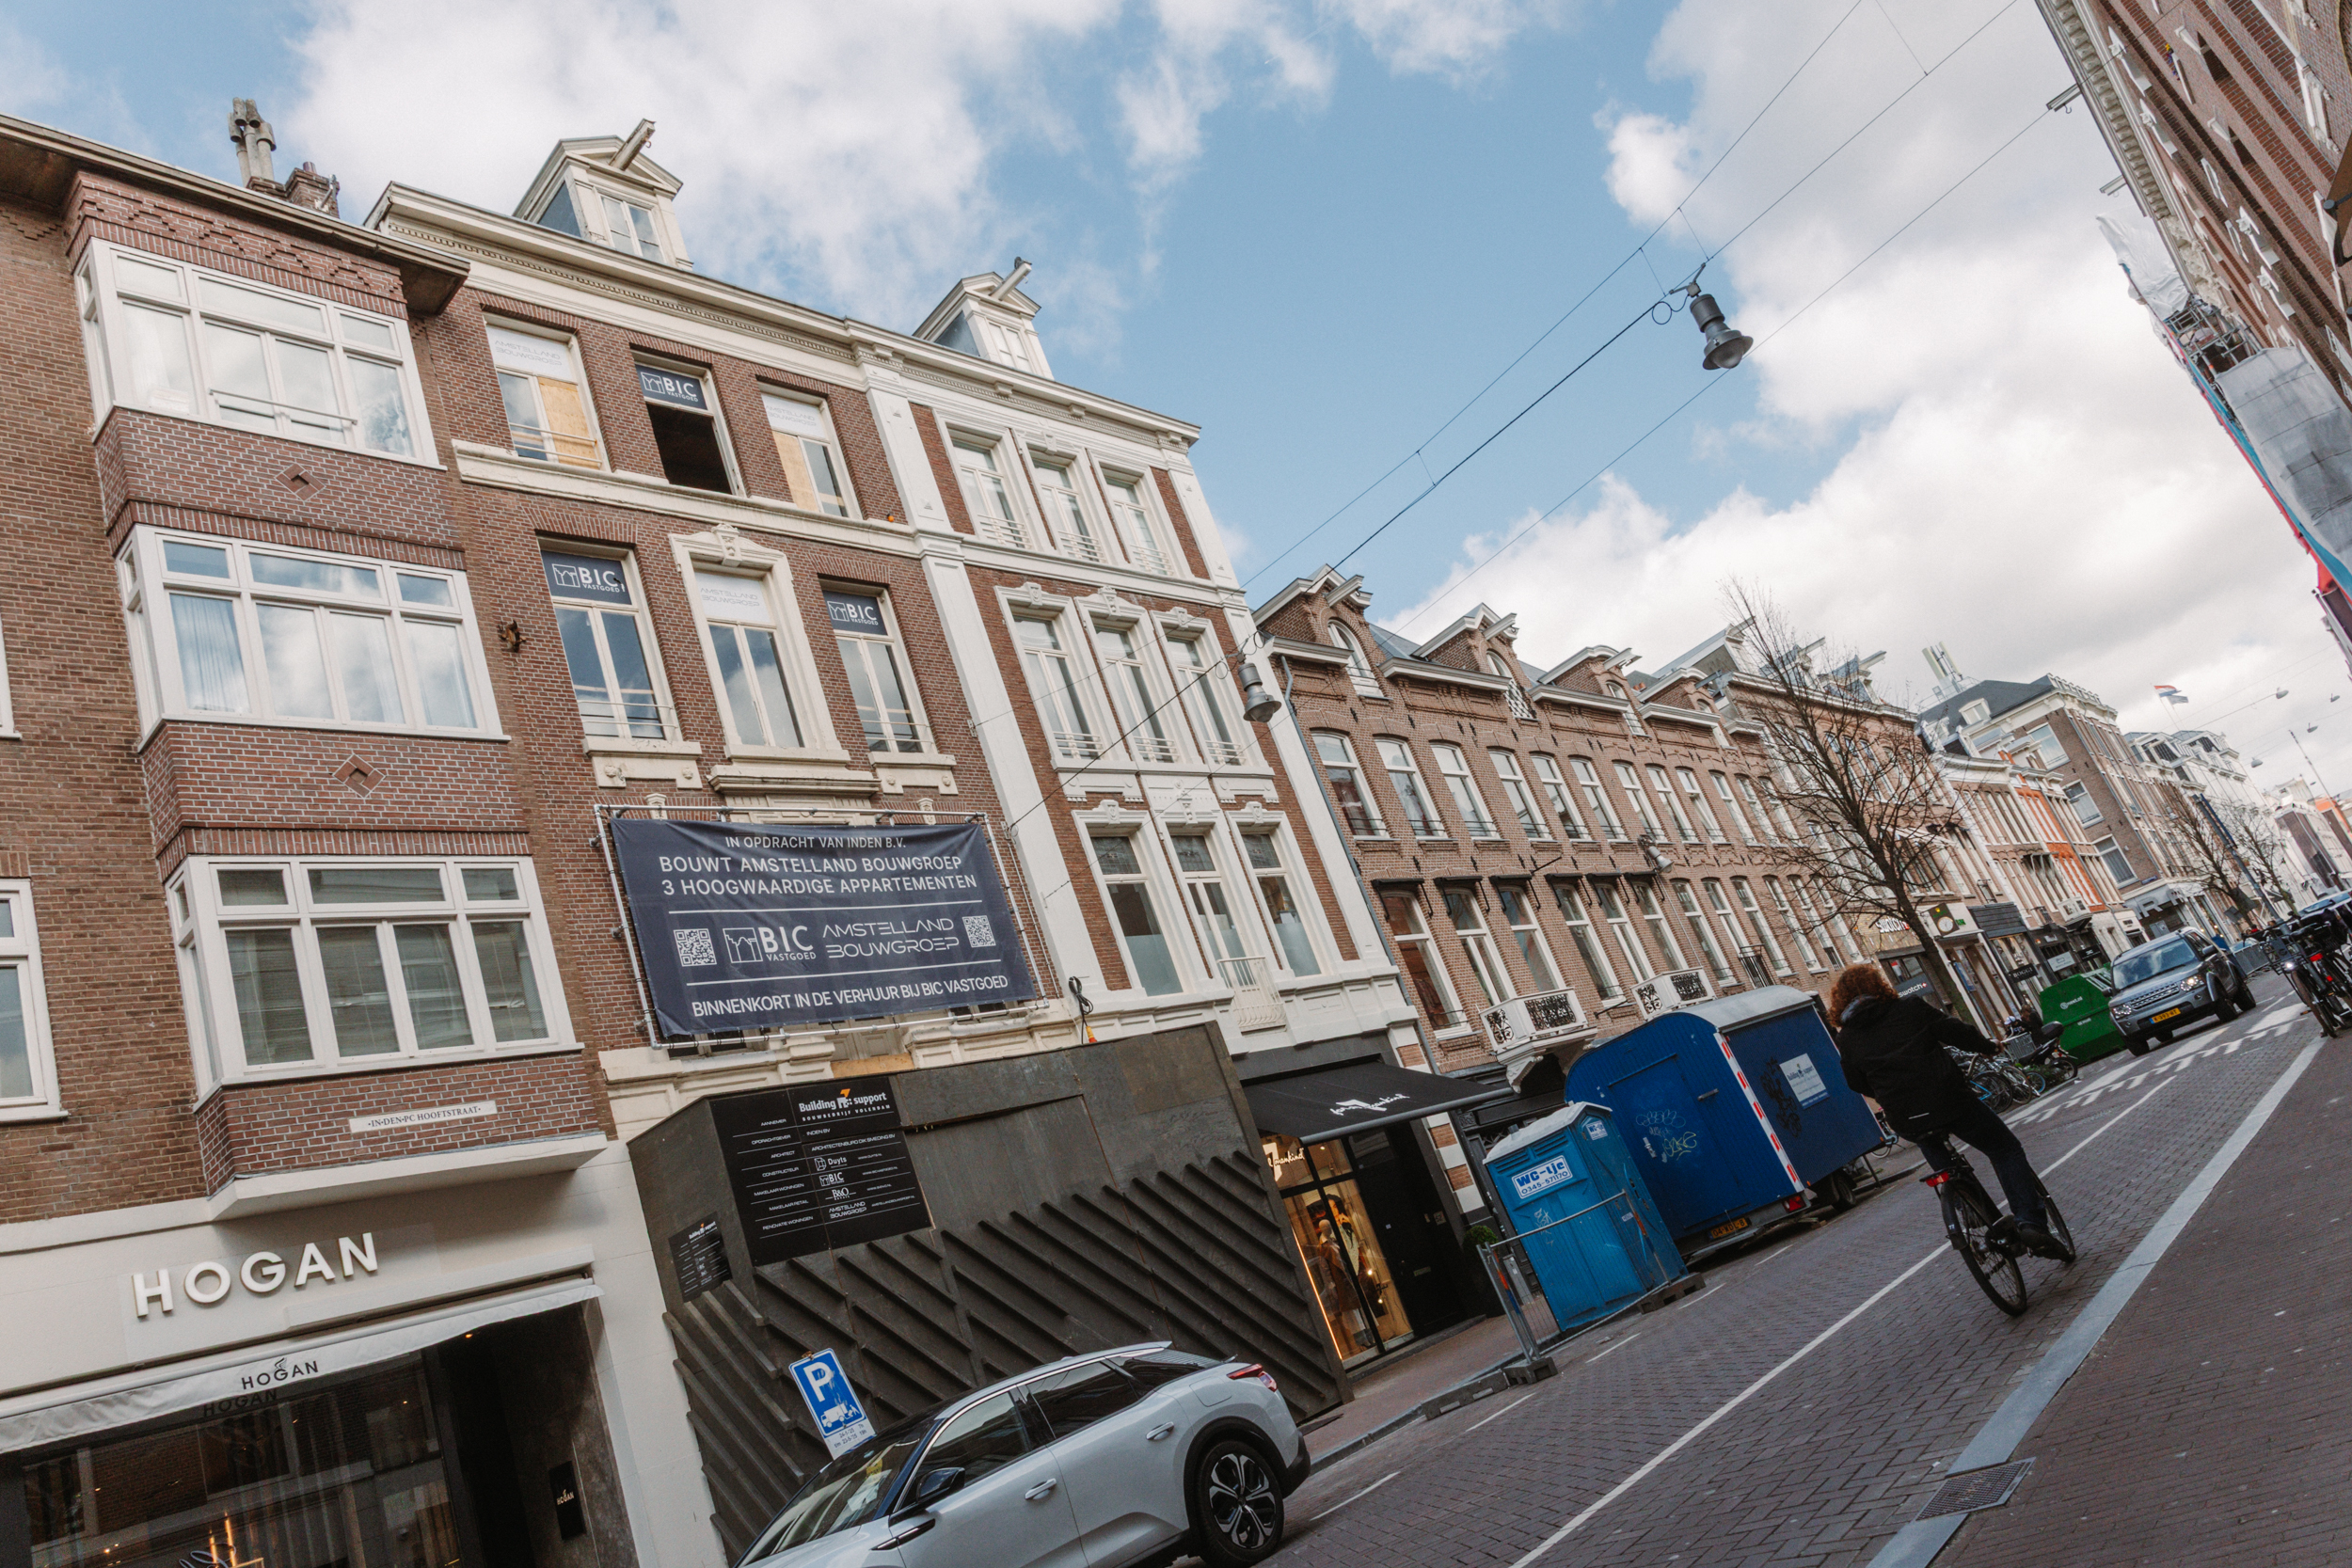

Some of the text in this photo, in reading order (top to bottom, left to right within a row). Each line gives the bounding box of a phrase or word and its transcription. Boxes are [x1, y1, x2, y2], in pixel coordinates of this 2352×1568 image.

[495, 340, 561, 359] AMSTELLAND
[496, 346, 563, 366] BOUWGROEP
[664, 377, 697, 397] BIC
[667, 391, 699, 403] VASTGOED
[578, 566, 618, 587] BIC
[582, 583, 621, 594] VASTGOED
[700, 587, 758, 600] AMSTELLAND
[701, 594, 760, 607] BOUWGROEP
[847, 603, 877, 621] BIC
[725, 836, 906, 848] IN OPDRACHT VAN INDEN B.V.
[659, 856, 961, 873] BOUWT AMSTELLAND BOUWGROEP
[661, 874, 977, 895] 3 HOOGWAARDIGE APPARTEMENTEN
[822, 918, 954, 939] AMSTELLAND
[757, 926, 814, 953] BIC
[825, 936, 960, 958] BOUWGROEP
[766, 951, 817, 961] VASTGOED
[691, 974, 1009, 1017] BINNENKORT IN DE VERHUUR BIJ BIC VASTGOED
[1898, 983, 1923, 998] swatch
[799, 1092, 887, 1113] Building support
[828, 1172, 844, 1182] BIC
[1521, 1171, 1568, 1194] 0345-571170
[131, 1232, 378, 1319] HOGAN
[241, 1360, 319, 1390] HOGAN
[803, 1362, 834, 1402] P
